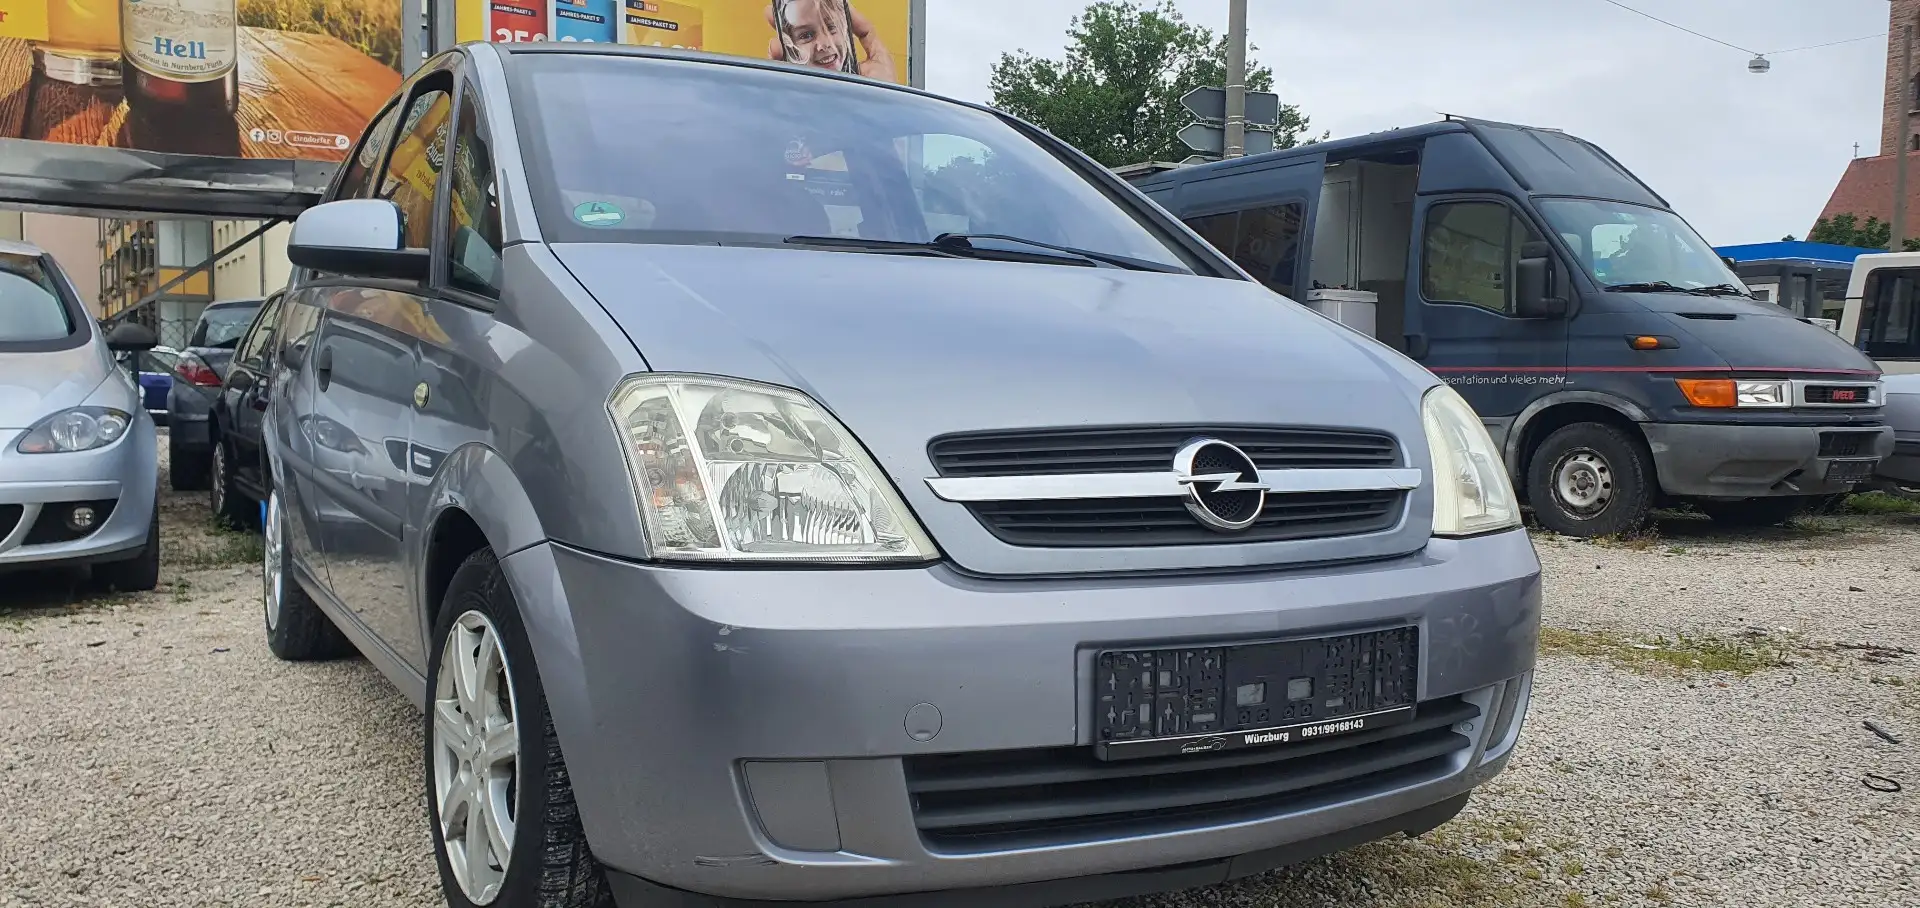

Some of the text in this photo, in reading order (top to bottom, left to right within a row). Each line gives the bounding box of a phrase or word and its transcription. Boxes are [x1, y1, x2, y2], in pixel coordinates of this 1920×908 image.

[630, 16, 669, 28] JAHRES-PAKET
[154, 36, 206, 60] Hell
[1490, 374, 1508, 385] und
[1509, 374, 1537, 385] vieles
[1832, 389, 1856, 401] IVECO
[1244, 719, 1364, 744] Würzburg 0931/99168143
